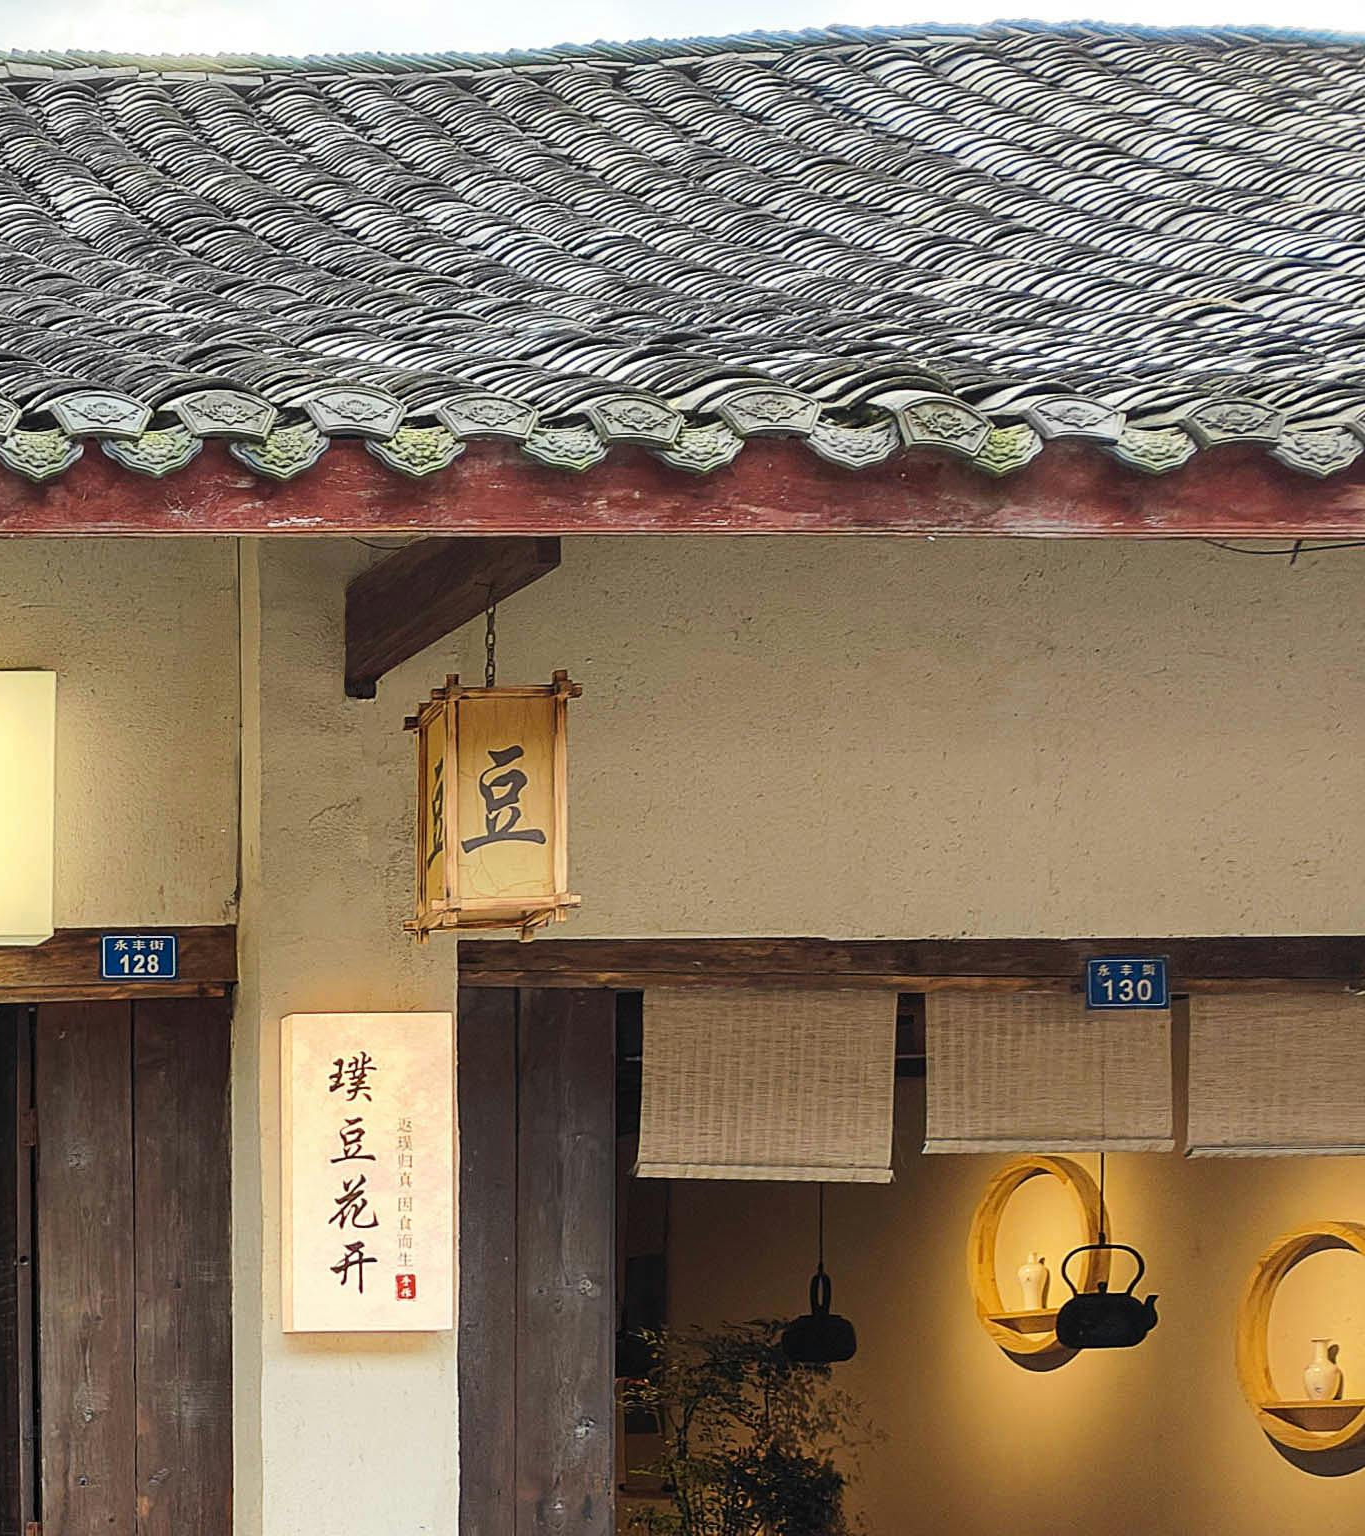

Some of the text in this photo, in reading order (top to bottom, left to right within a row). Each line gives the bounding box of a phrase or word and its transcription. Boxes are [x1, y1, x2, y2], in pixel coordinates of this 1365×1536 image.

[461, 744, 548, 854] 豆
[119, 953, 160, 974] 128
[1101, 979, 1153, 1002] 130
[328, 1051, 379, 1294] 璞豆花开
